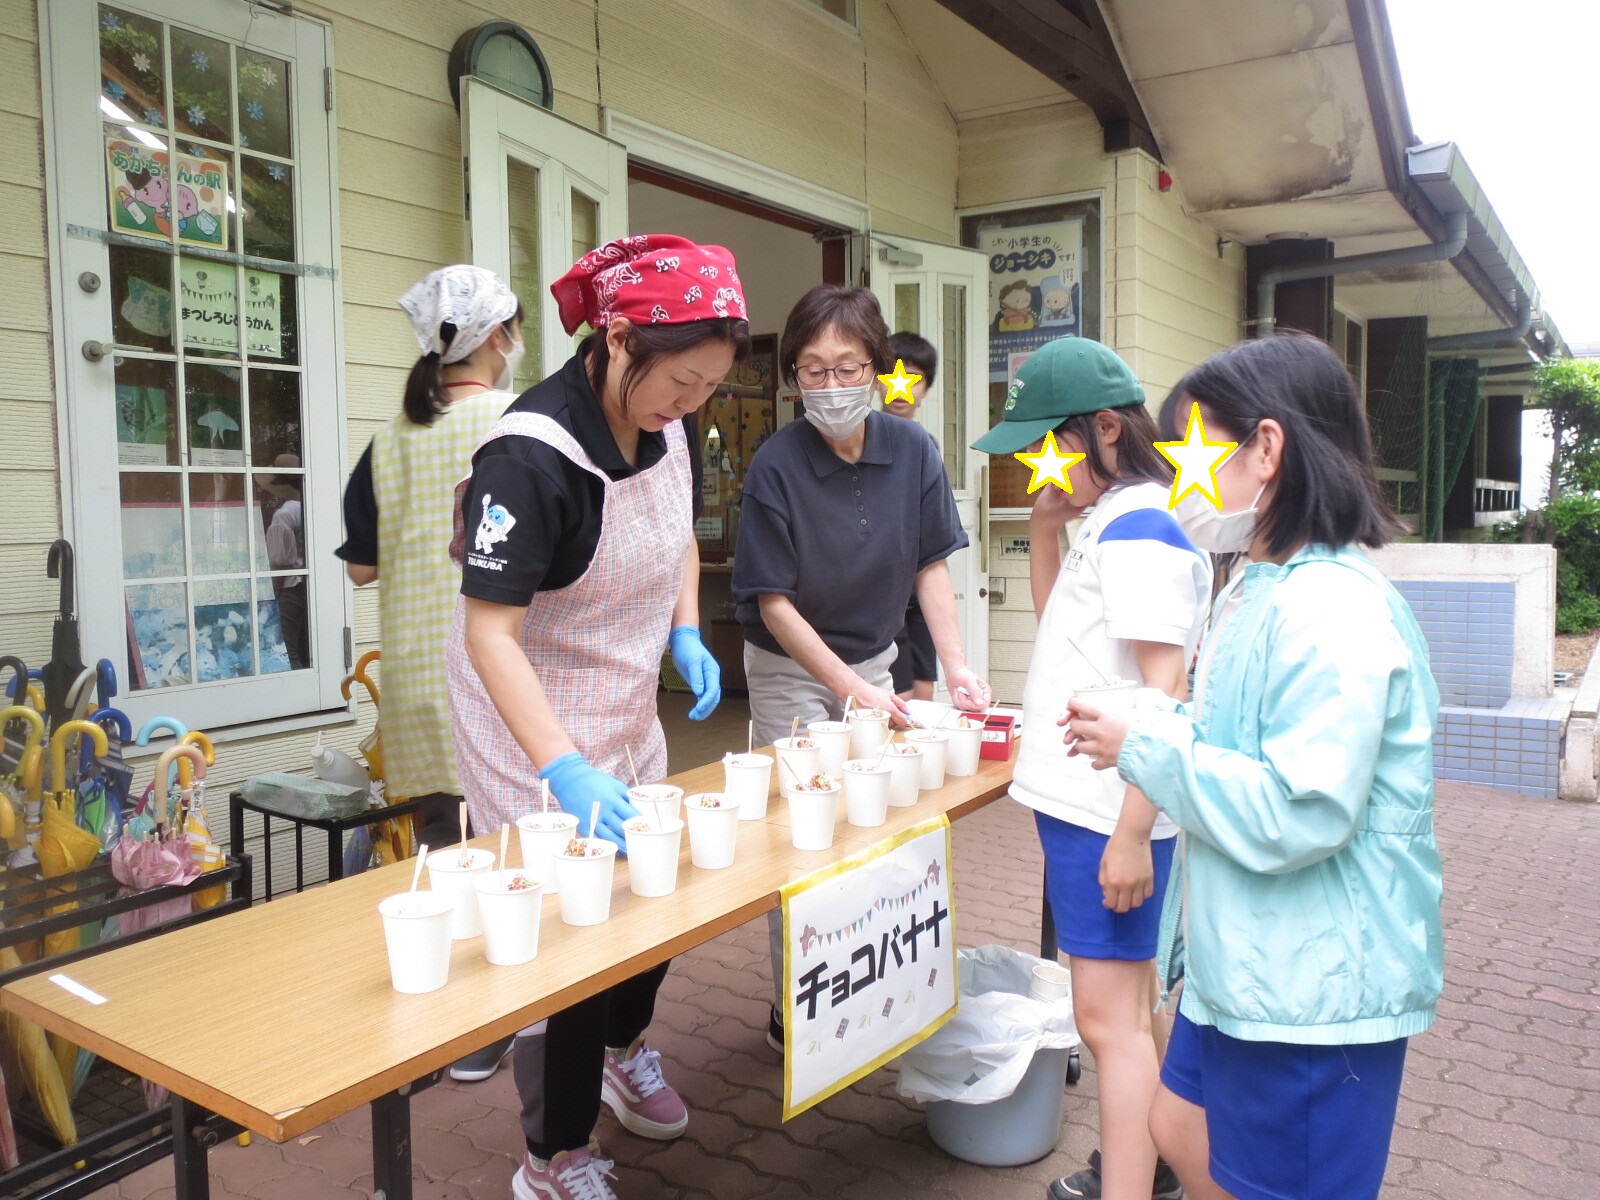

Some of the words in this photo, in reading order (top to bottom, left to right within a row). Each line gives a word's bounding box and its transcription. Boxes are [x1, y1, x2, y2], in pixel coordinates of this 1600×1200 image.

[112, 150, 222, 190] あかちんの駅
[994, 252, 1052, 270] ジョーシキ
[468, 556, 503, 571] TSUKUBA
[796, 899, 949, 1021] チョコバナナ
